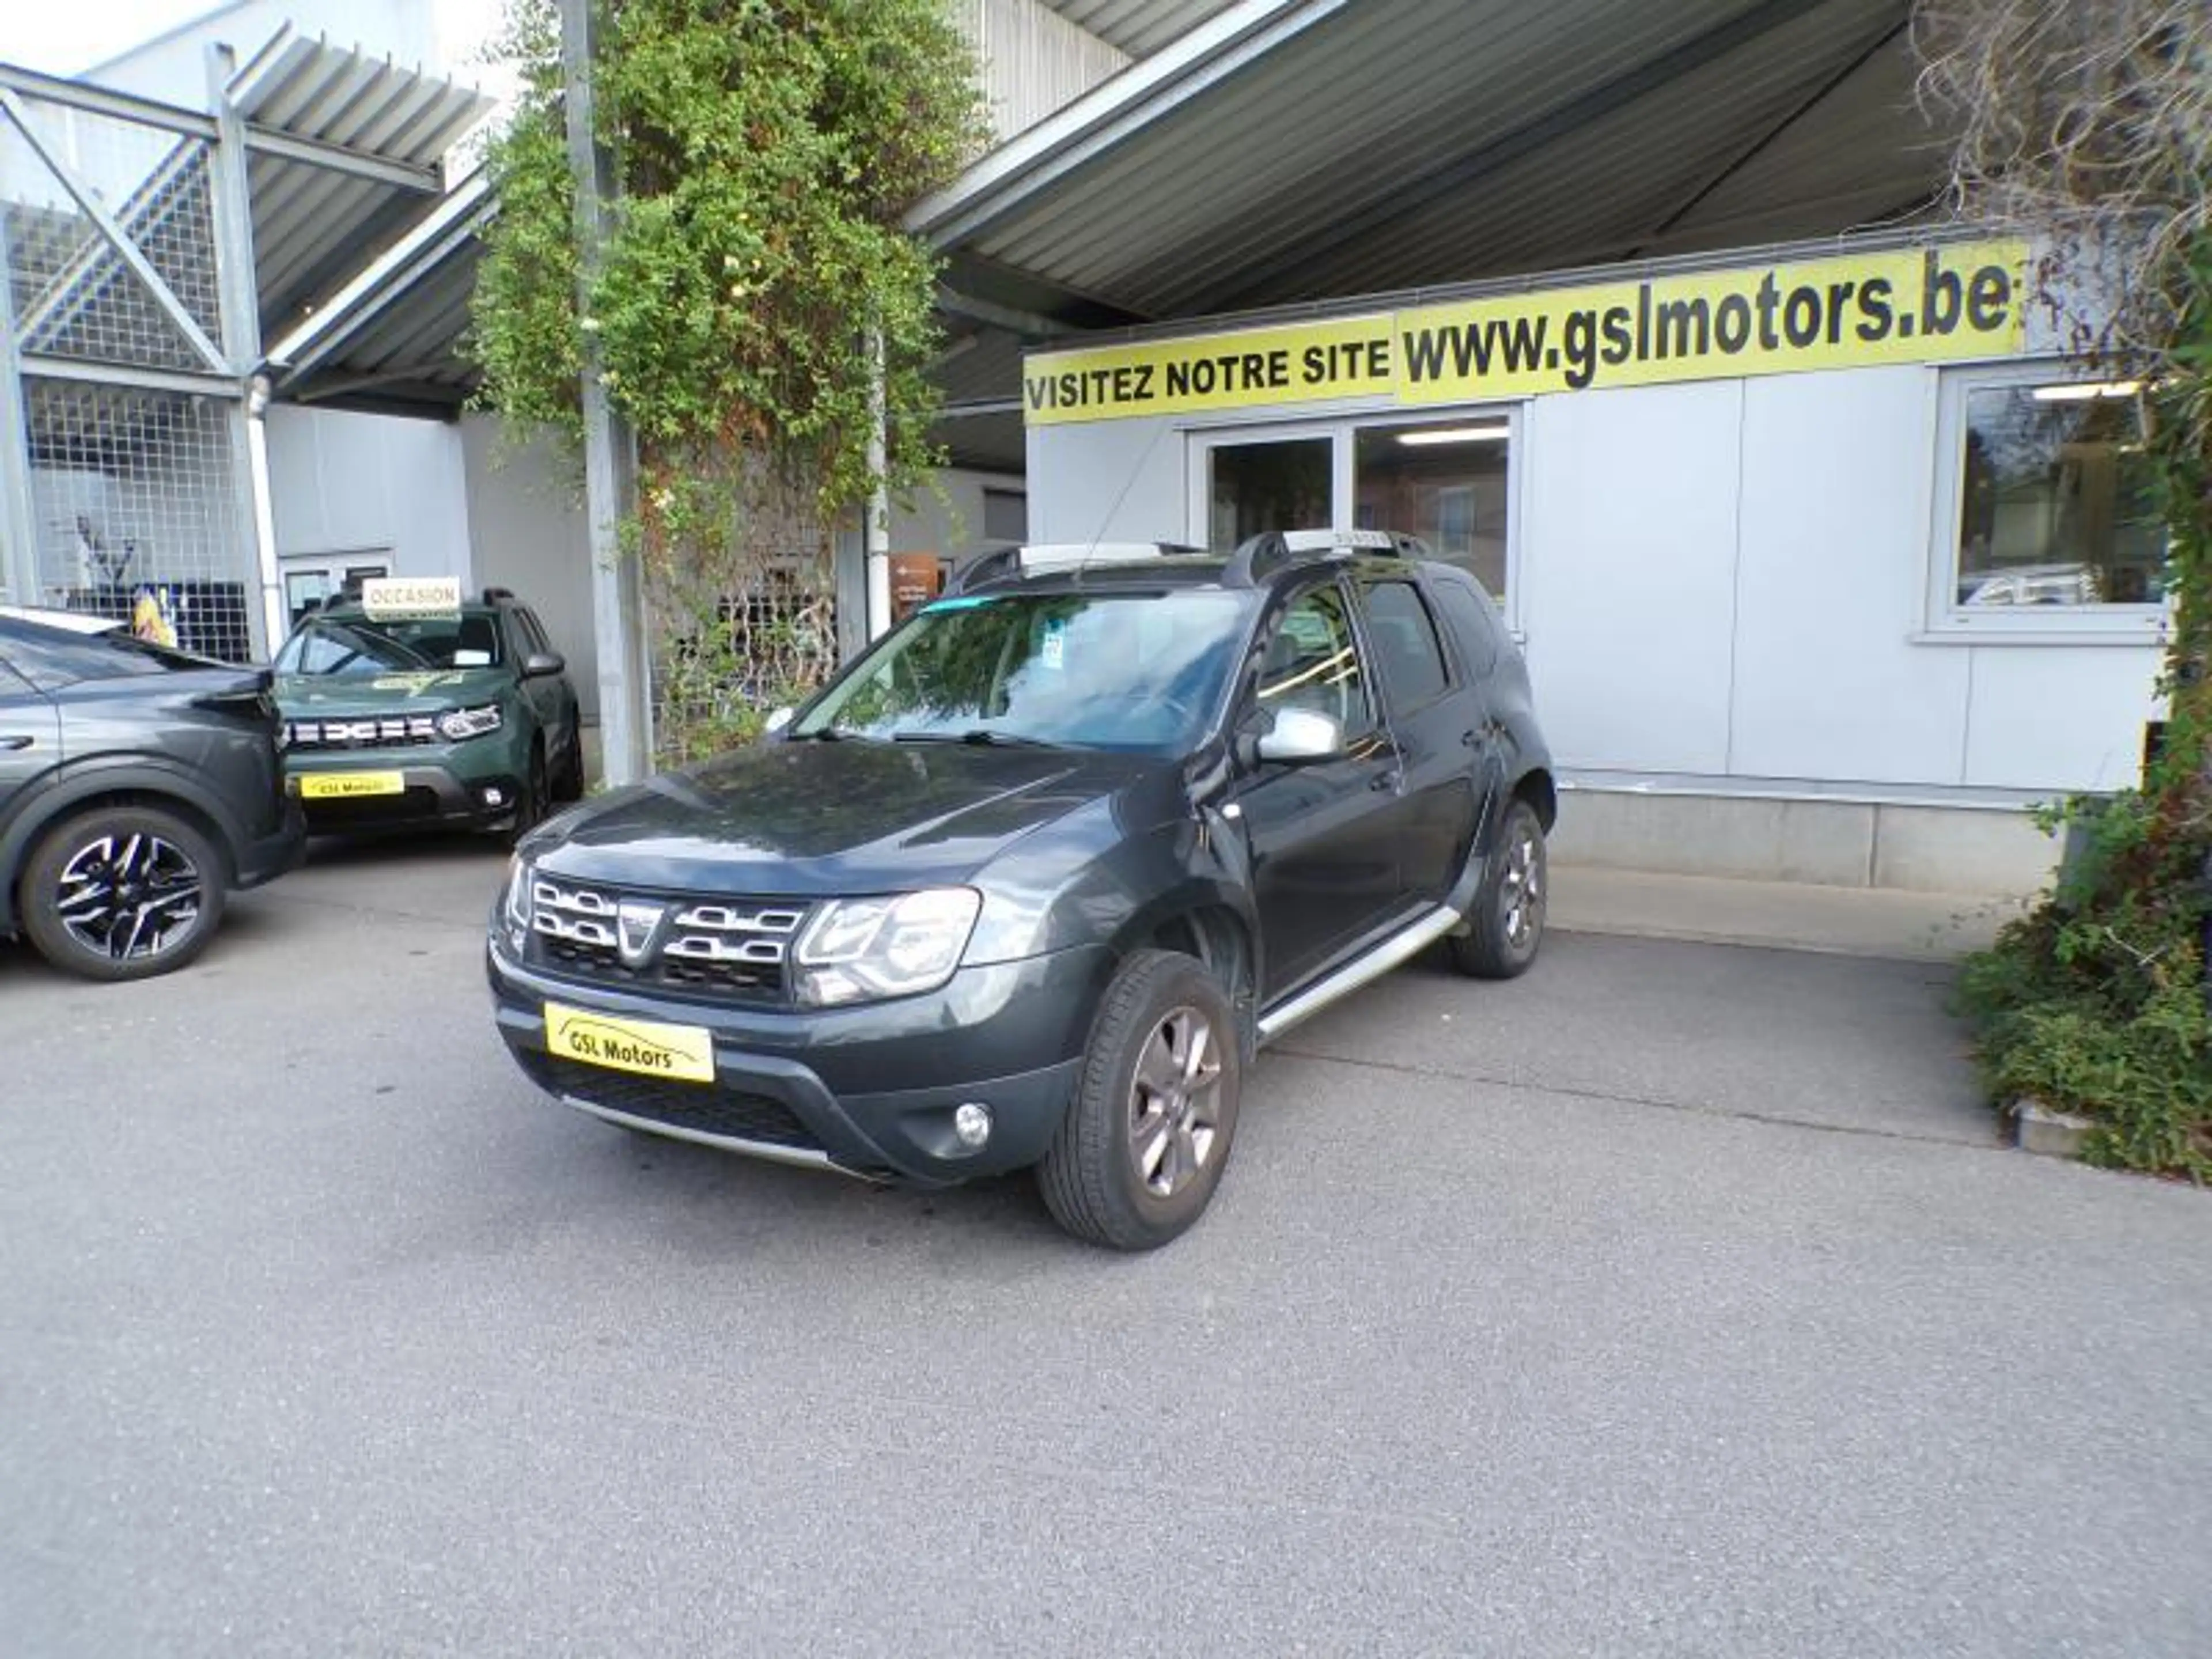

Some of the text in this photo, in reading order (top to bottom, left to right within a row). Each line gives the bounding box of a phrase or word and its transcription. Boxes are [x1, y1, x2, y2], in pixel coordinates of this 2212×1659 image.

[1402, 250, 2010, 390] www.gslmotors.be
[1026, 340, 1390, 410] VISITEZ NOTRE SITE
[370, 586, 455, 604] OCCASION
[569, 1031, 672, 1068] GSL Motors
